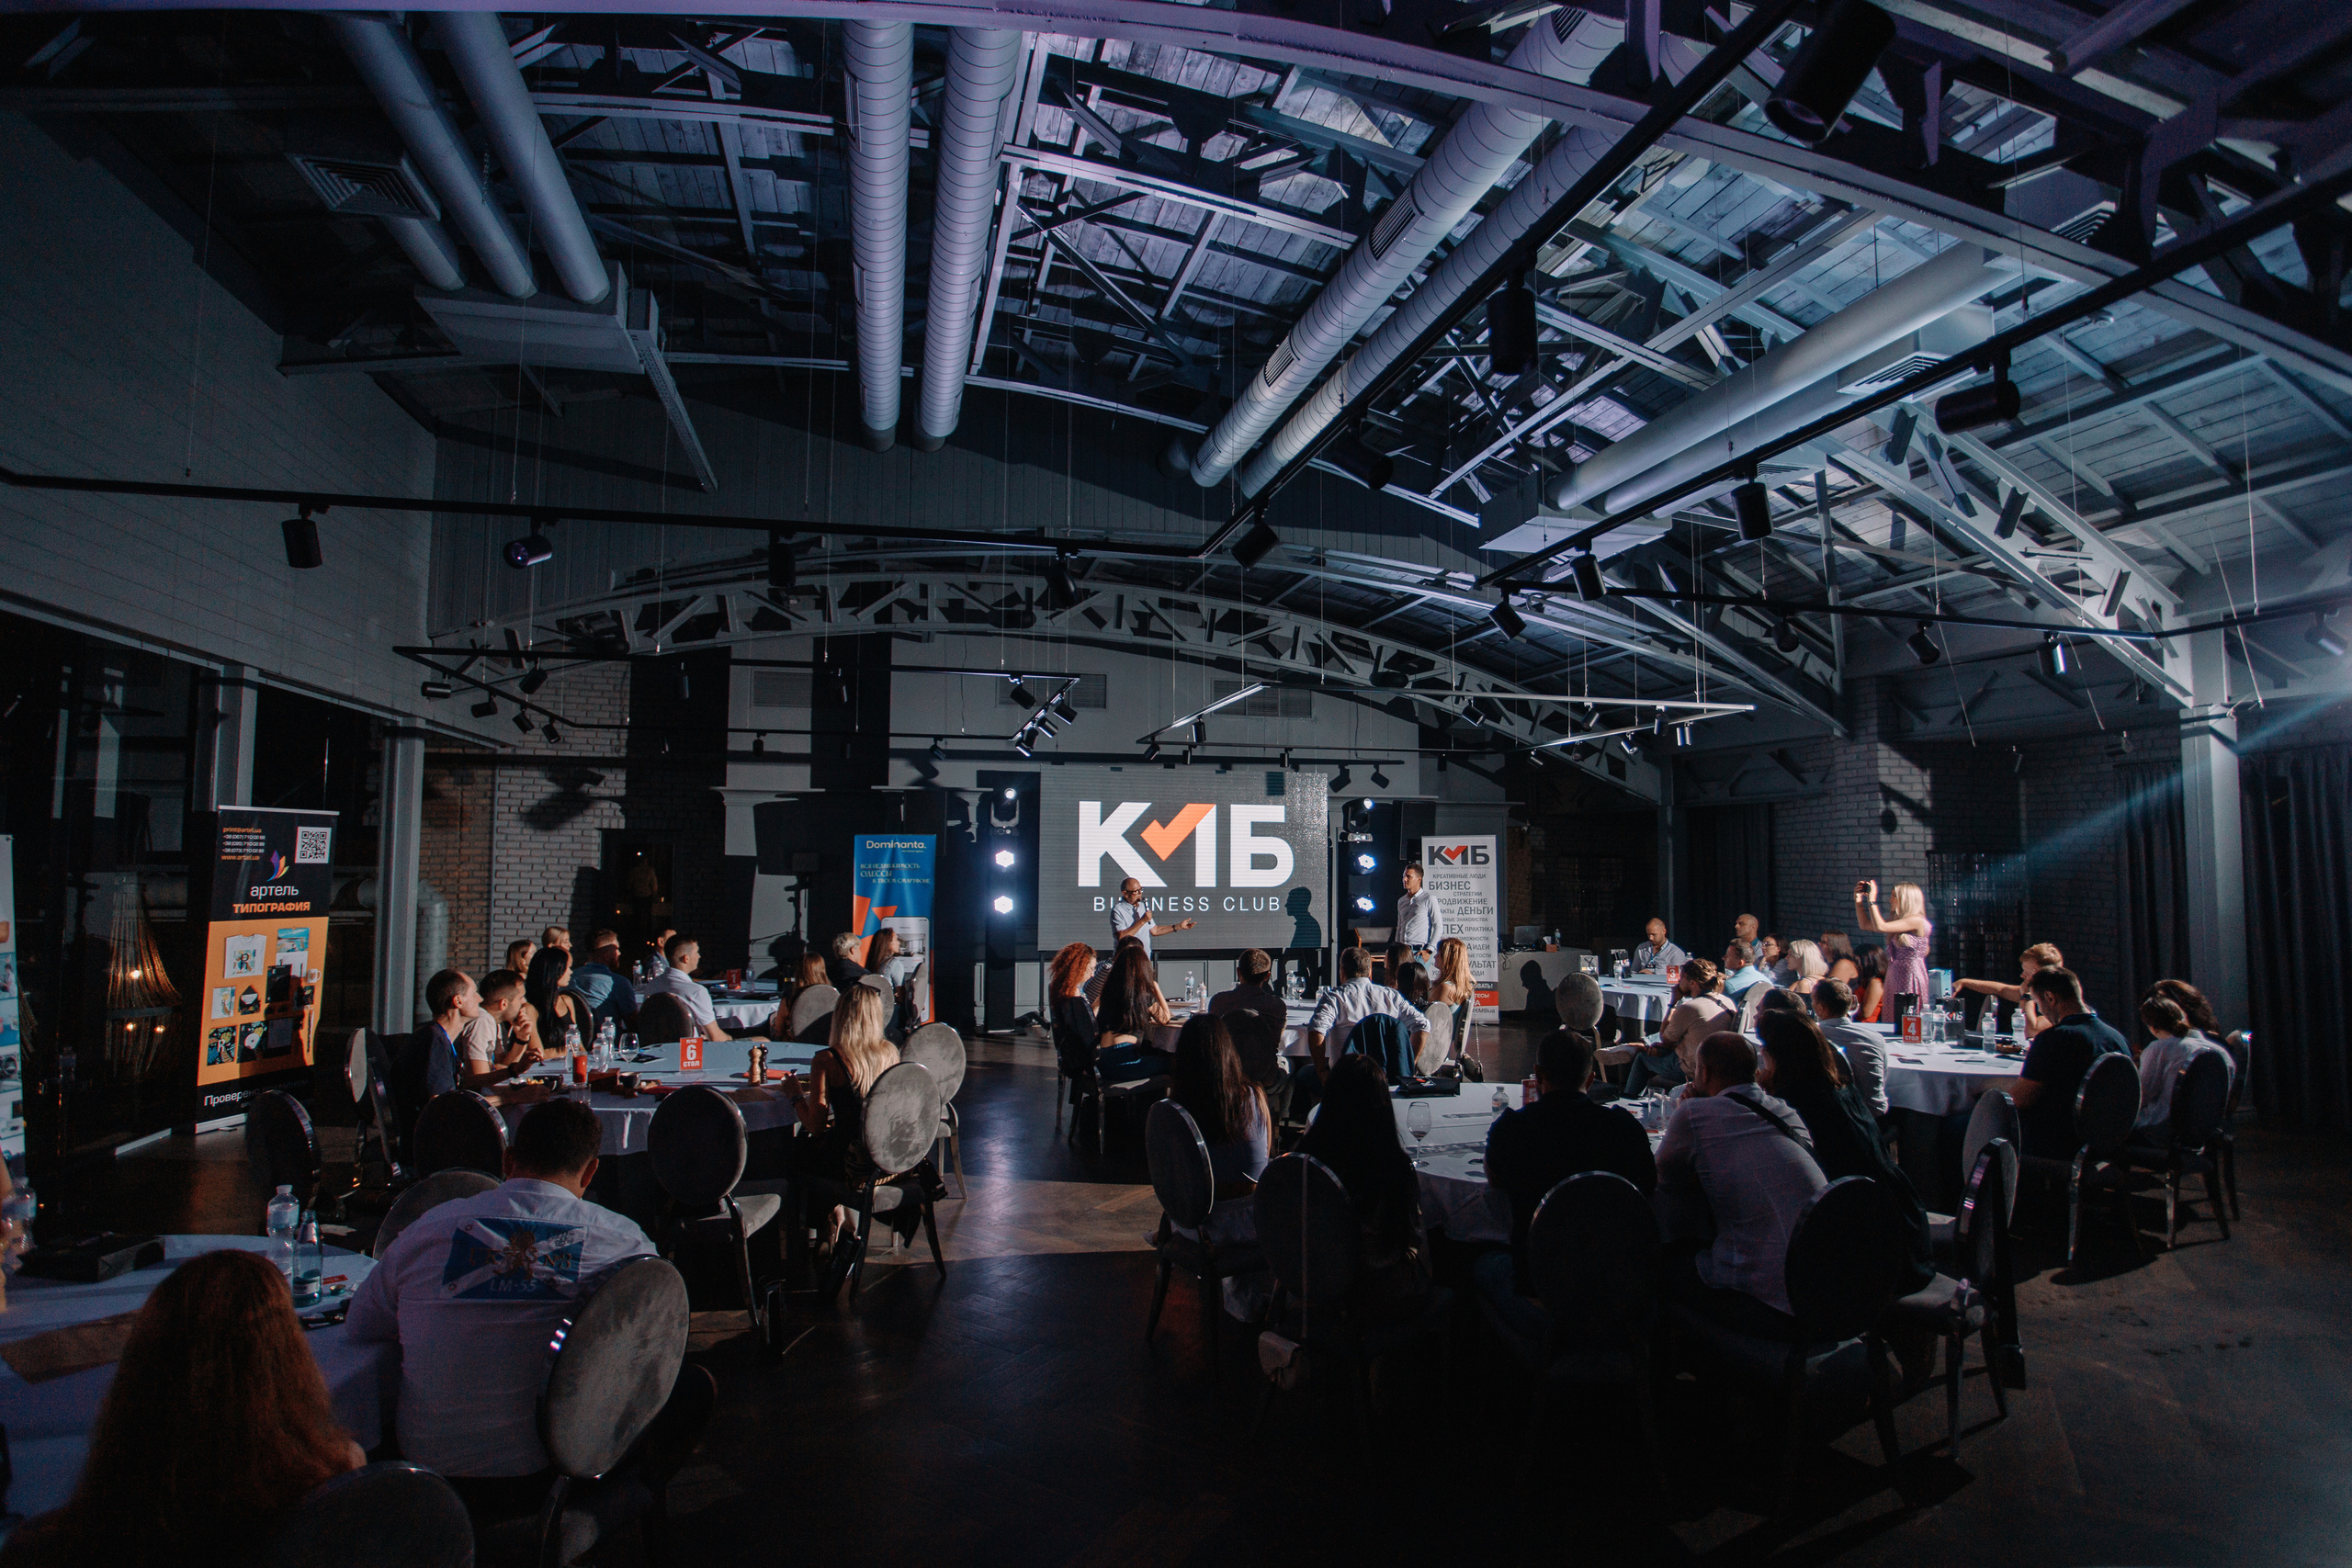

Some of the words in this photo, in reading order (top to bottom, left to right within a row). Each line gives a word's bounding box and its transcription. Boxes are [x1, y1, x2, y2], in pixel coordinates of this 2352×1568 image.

[866, 840, 926, 849] Dominanta.
[1429, 881, 1470, 890] БИЗНЕС
[250, 886, 300, 899] артель
[232, 901, 311, 913] ТИПОГРАФИЯ
[1093, 897, 1210, 911] BUNESS
[1223, 897, 1280, 911] CLUB
[1457, 907, 1494, 916] ДЕНЬГИ
[1669, 969, 1676, 977] 3
[1907, 1022, 1917, 1035] 4
[686, 1044, 696, 1060] 6
[203, 1088, 260, 1108] Проверено
